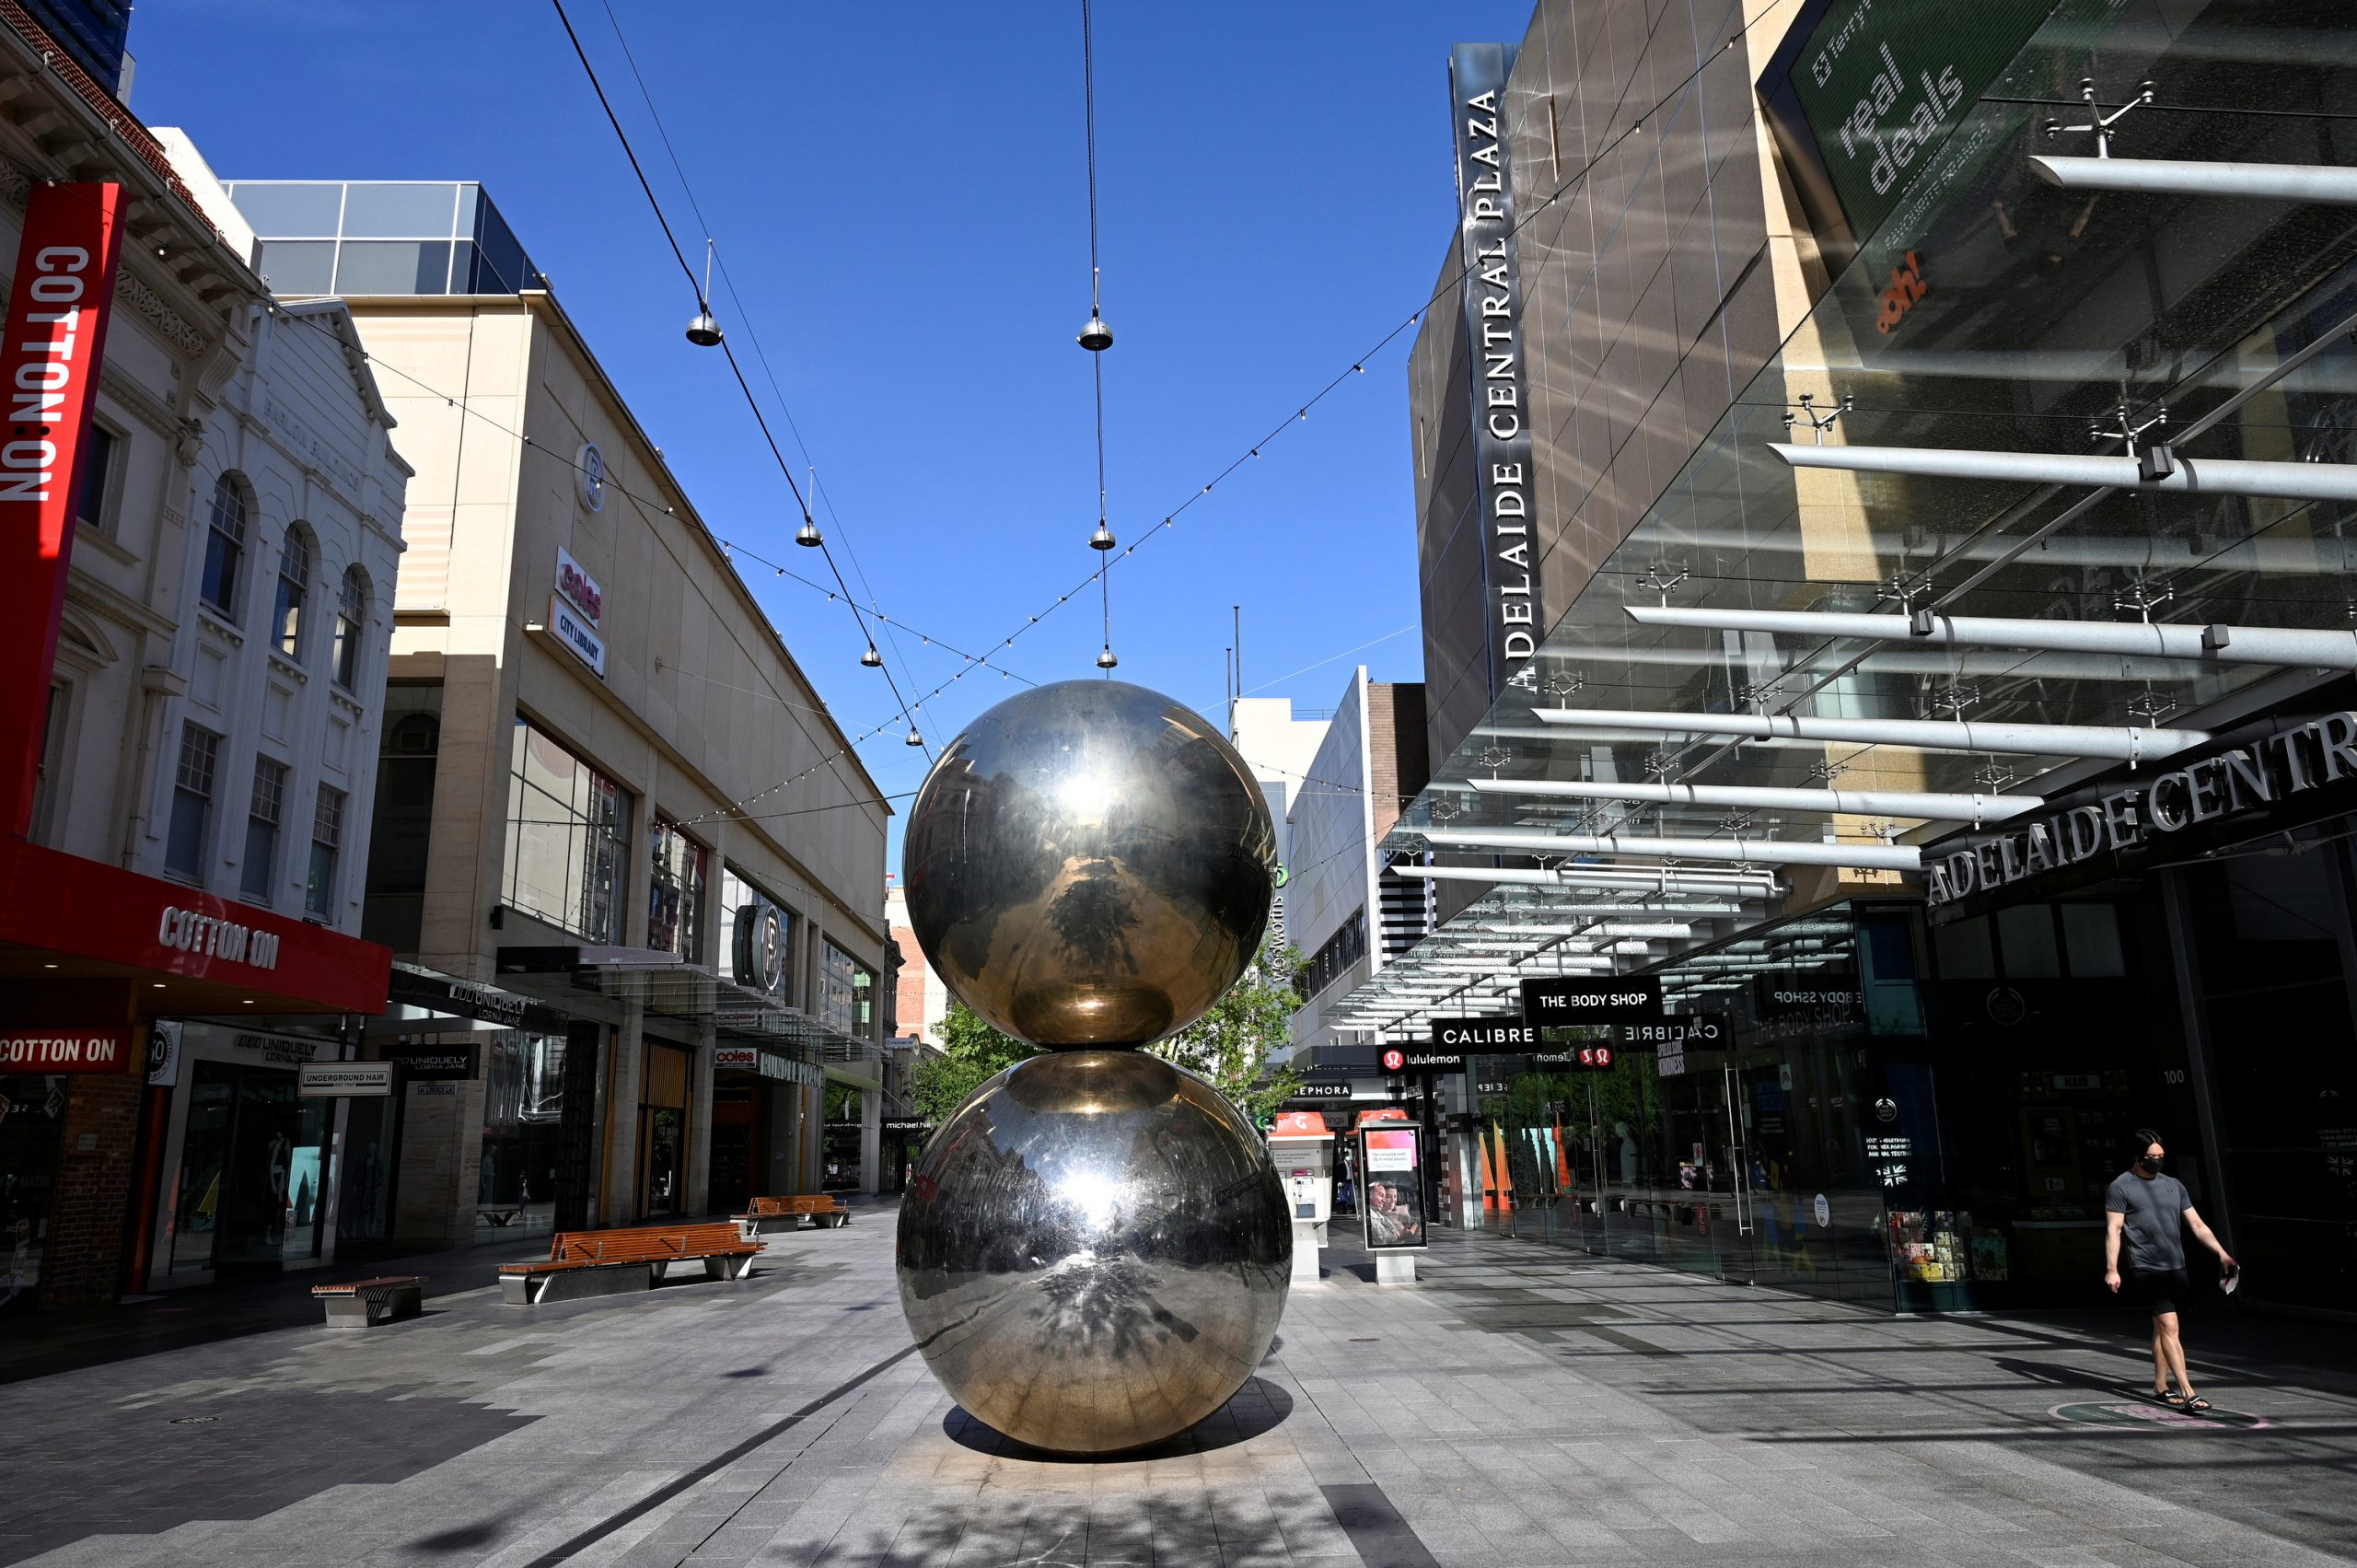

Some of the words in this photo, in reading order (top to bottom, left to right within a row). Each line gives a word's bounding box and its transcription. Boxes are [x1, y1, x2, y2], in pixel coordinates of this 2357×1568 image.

[1826, 0, 1872, 59] Terry
[1840, 41, 1904, 159] real
[1871, 64, 1964, 195] deals
[1468, 89, 1504, 221] PLAZA
[9, 246, 89, 423] COTTON
[1478, 238, 1519, 441] CENTRAL
[559, 563, 601, 621] coles
[1493, 463, 1538, 695] ADELAIDE
[560, 614, 575, 639] CITY
[574, 627, 599, 662] LIBRARY
[1928, 789, 2142, 907] ADELAIDE
[2149, 711, 2357, 832] CENTR
[158, 906, 249, 964] COTTON
[249, 931, 280, 970] ON
[475, 989, 526, 1015] UNIQUELY
[1539, 995, 1566, 1008] THE
[1571, 994, 1607, 1006] BODY
[1610, 993, 1647, 1005] SHOP
[478, 1007, 503, 1022] LORNA
[503, 1015, 521, 1027] JANE
[262, 1037, 318, 1057] UNIQUELY
[1443, 1028, 1535, 1045] CALIBRE
[0, 1039, 80, 1062] COTTON
[87, 1039, 116, 1062] ON
[410, 1056, 468, 1064] UNIQUELY
[716, 1050, 754, 1063] coles
[1406, 1053, 1460, 1065] lululemon
[307, 1074, 365, 1082] UNDERGROUND
[2064, 1076, 2089, 1087] HAIR
[2164, 1069, 2185, 1085] 100
